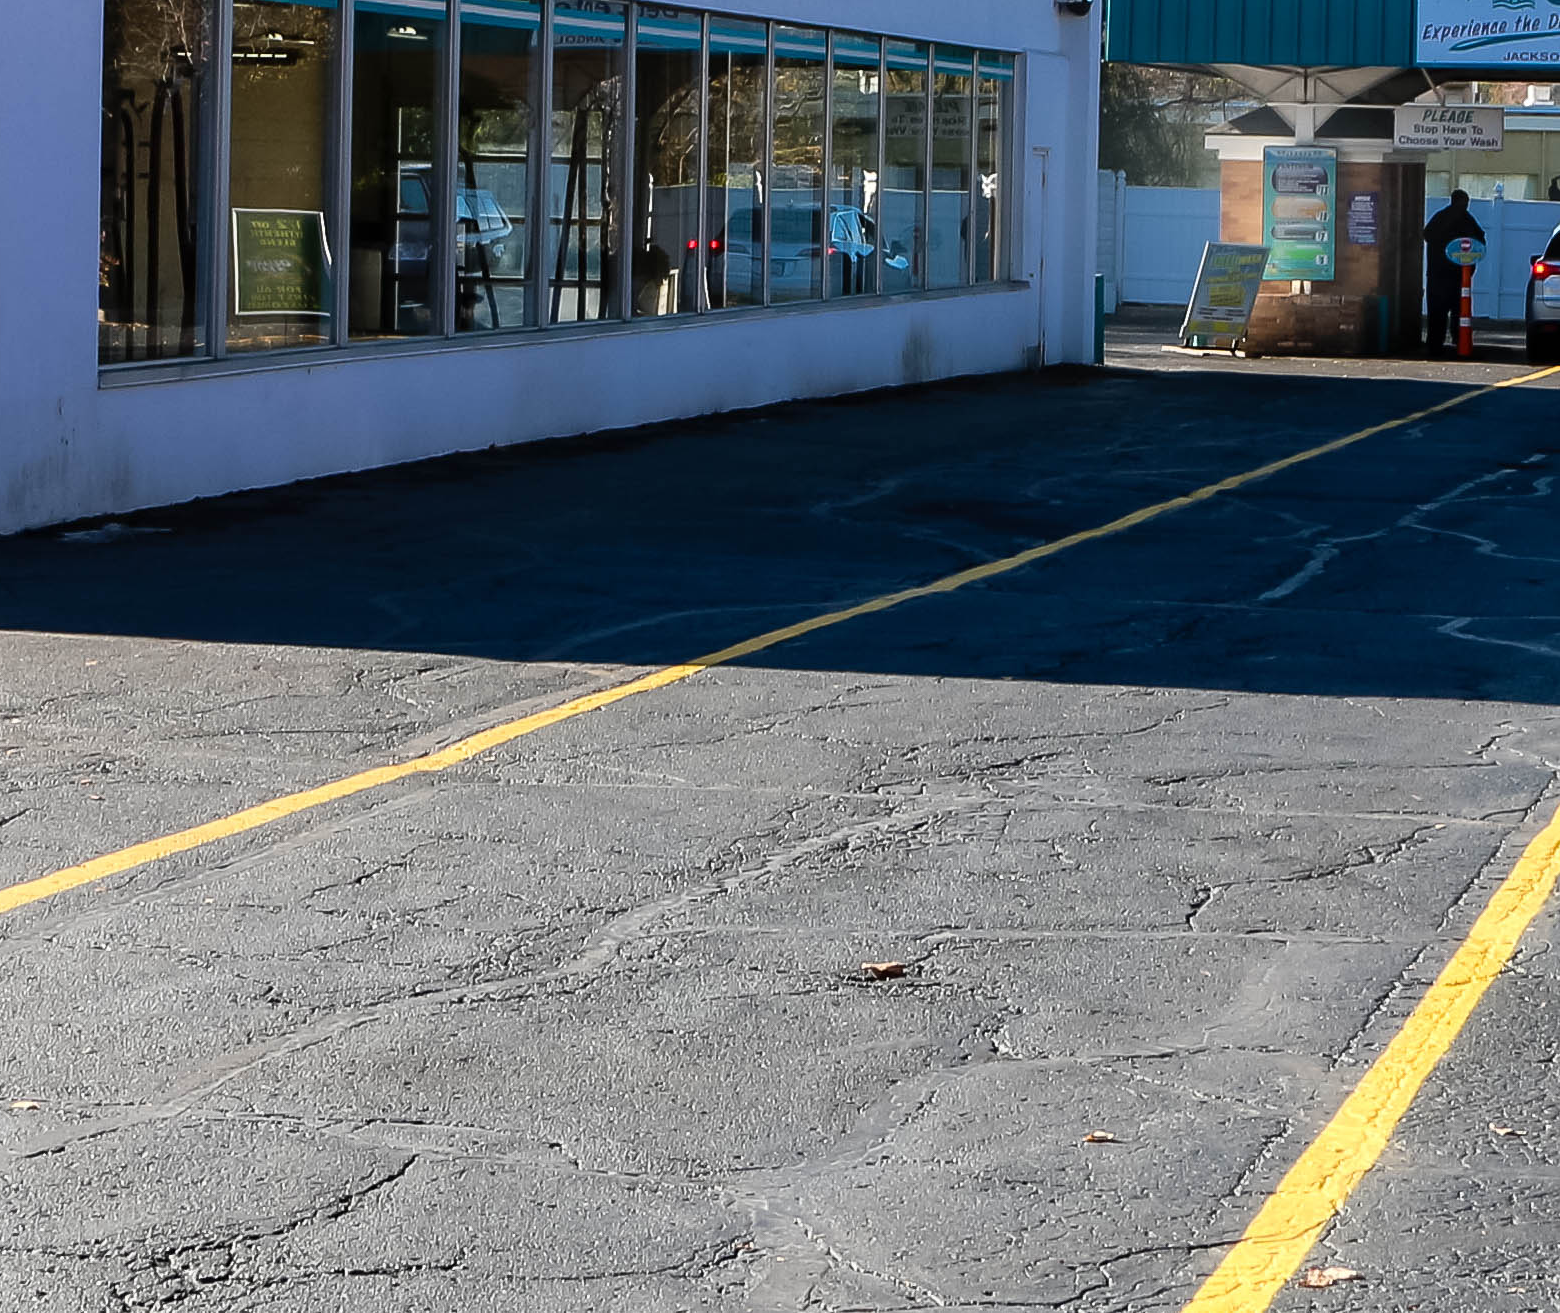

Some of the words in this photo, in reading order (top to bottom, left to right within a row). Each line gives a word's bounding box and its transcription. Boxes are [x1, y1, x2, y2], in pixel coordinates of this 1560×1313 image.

[1422, 18, 1508, 43] Experience
[1514, 14, 1541, 32] the
[1422, 109, 1475, 123] PLEASE
[1413, 124, 1438, 135] Stop
[1442, 125, 1467, 134] Here
[1472, 125, 1484, 135] To
[1398, 135, 1439, 145] Choose
[1443, 136, 1467, 146] Your
[1470, 137, 1499, 147] Wash
